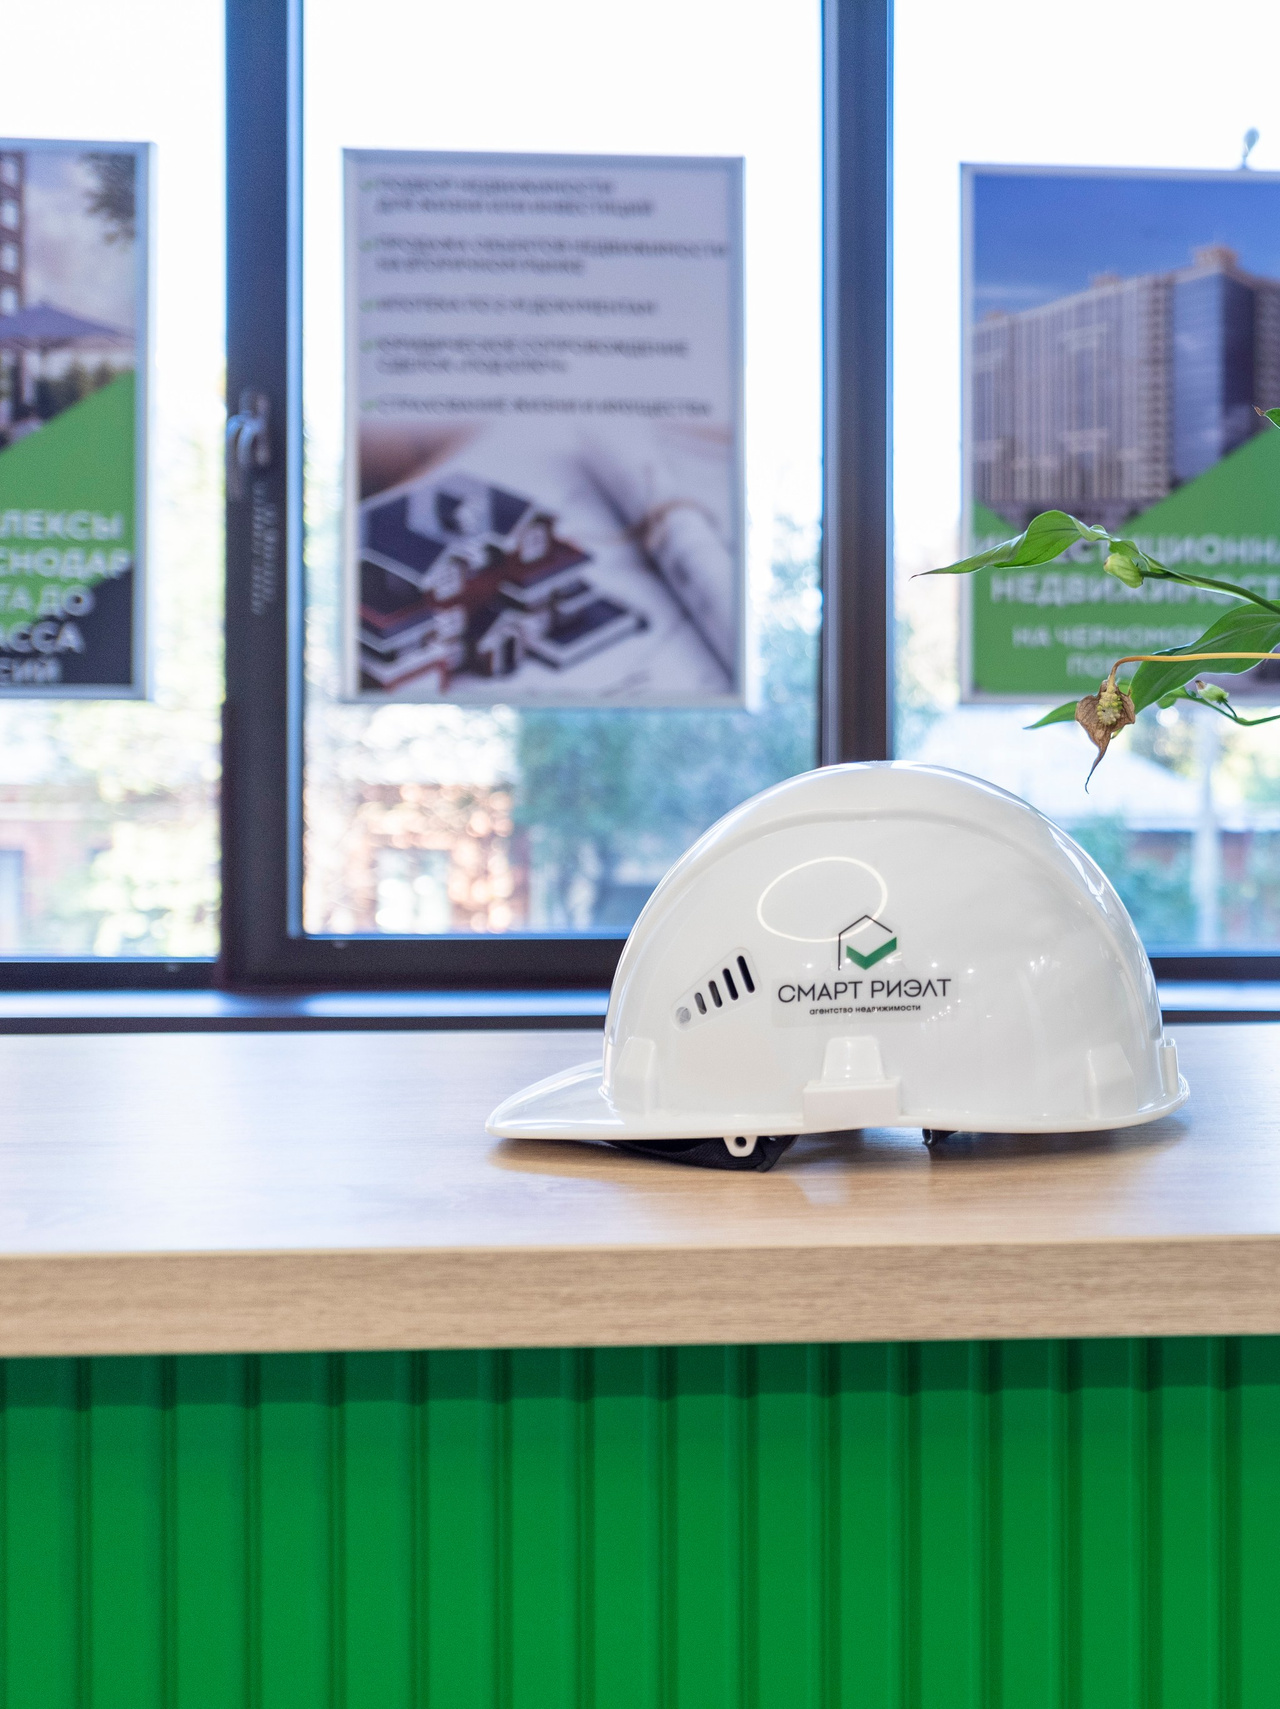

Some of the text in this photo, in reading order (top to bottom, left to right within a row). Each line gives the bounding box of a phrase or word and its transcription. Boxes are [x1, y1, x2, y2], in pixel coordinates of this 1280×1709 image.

[0, 509, 124, 541] ЛЕКСЫ
[36, 584, 97, 619] ДО
[1012, 624, 1208, 650] НА ЧЕРНОМО
[777, 978, 952, 1003] СМАРТ РИЭЛТ
[809, 1004, 921, 1016] агентство недвижимости
